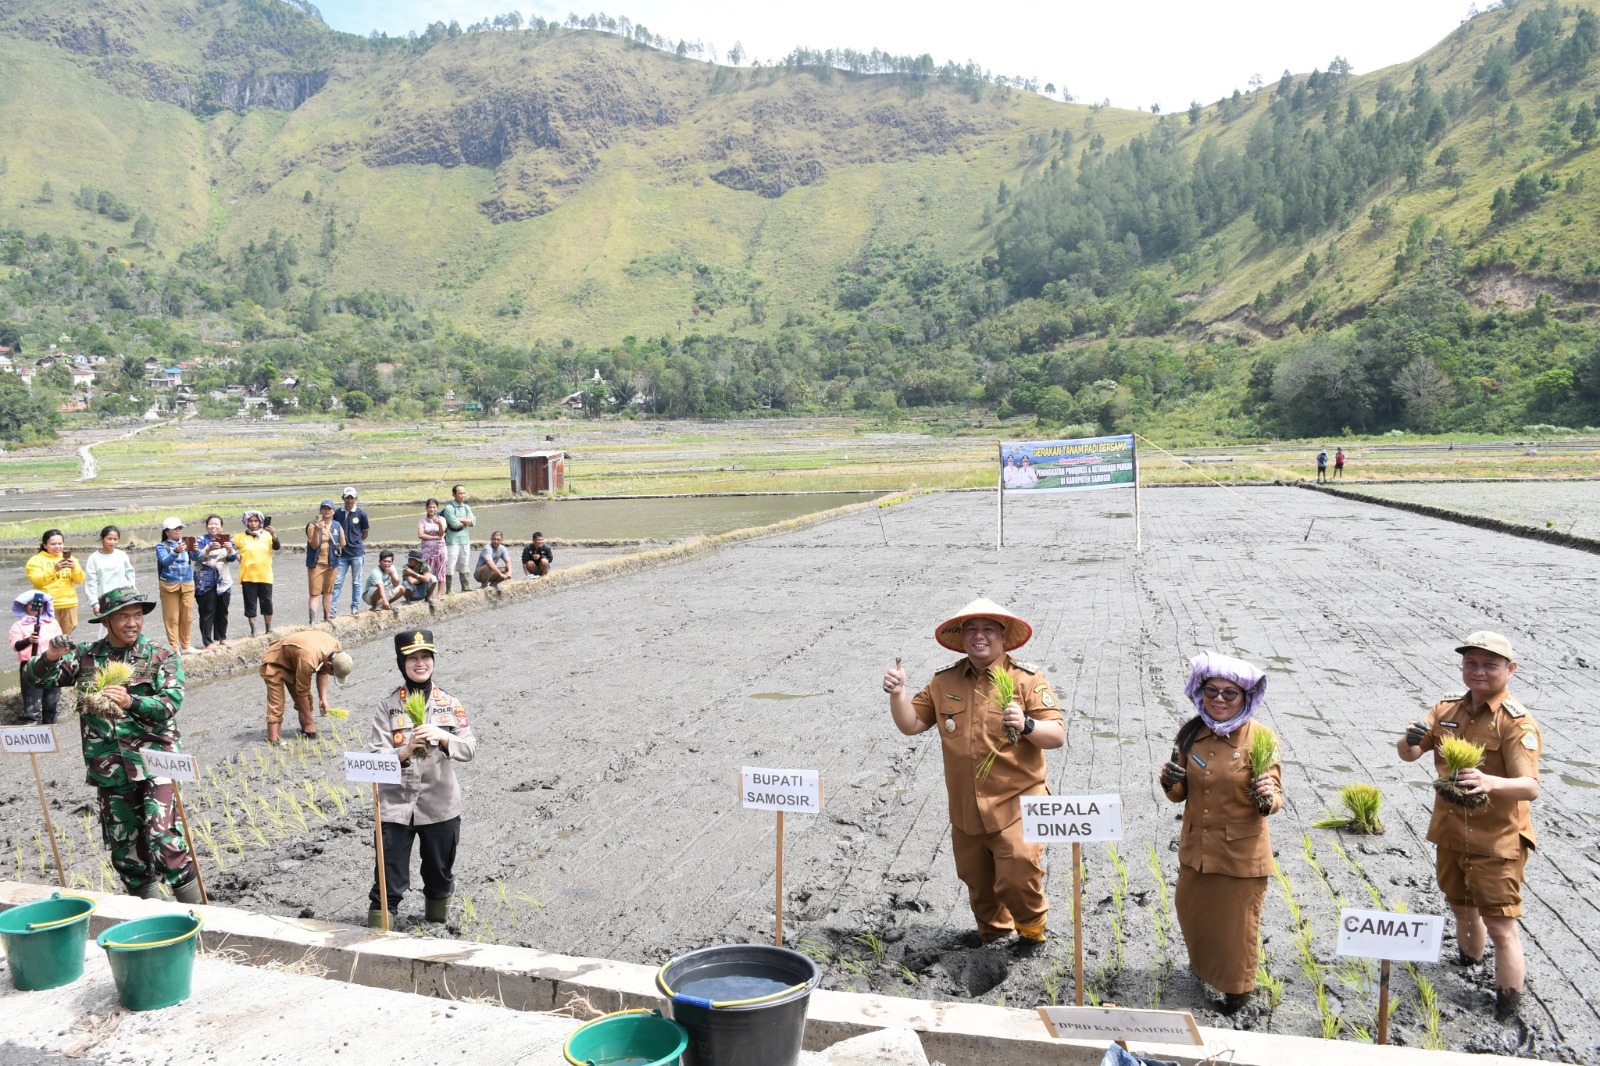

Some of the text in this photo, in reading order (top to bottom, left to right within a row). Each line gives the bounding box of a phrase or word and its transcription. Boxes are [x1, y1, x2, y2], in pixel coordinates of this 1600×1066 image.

[1033, 441, 1127, 457] GERAKAN TANAM PADI BERSAMA
[5, 733, 51, 746] DANDIM
[147, 754, 192, 773] KAJARI
[347, 759, 397, 772] KAPOLRES
[753, 773, 803, 787] BUPATI
[747, 791, 810, 807] SAMOSIR
[1027, 802, 1101, 816] KEPALA
[1037, 822, 1092, 837] DINAS
[1344, 916, 1424, 938] CAMAT
[1058, 1022, 1185, 1035] DPRD KAB. SAMOSIR
